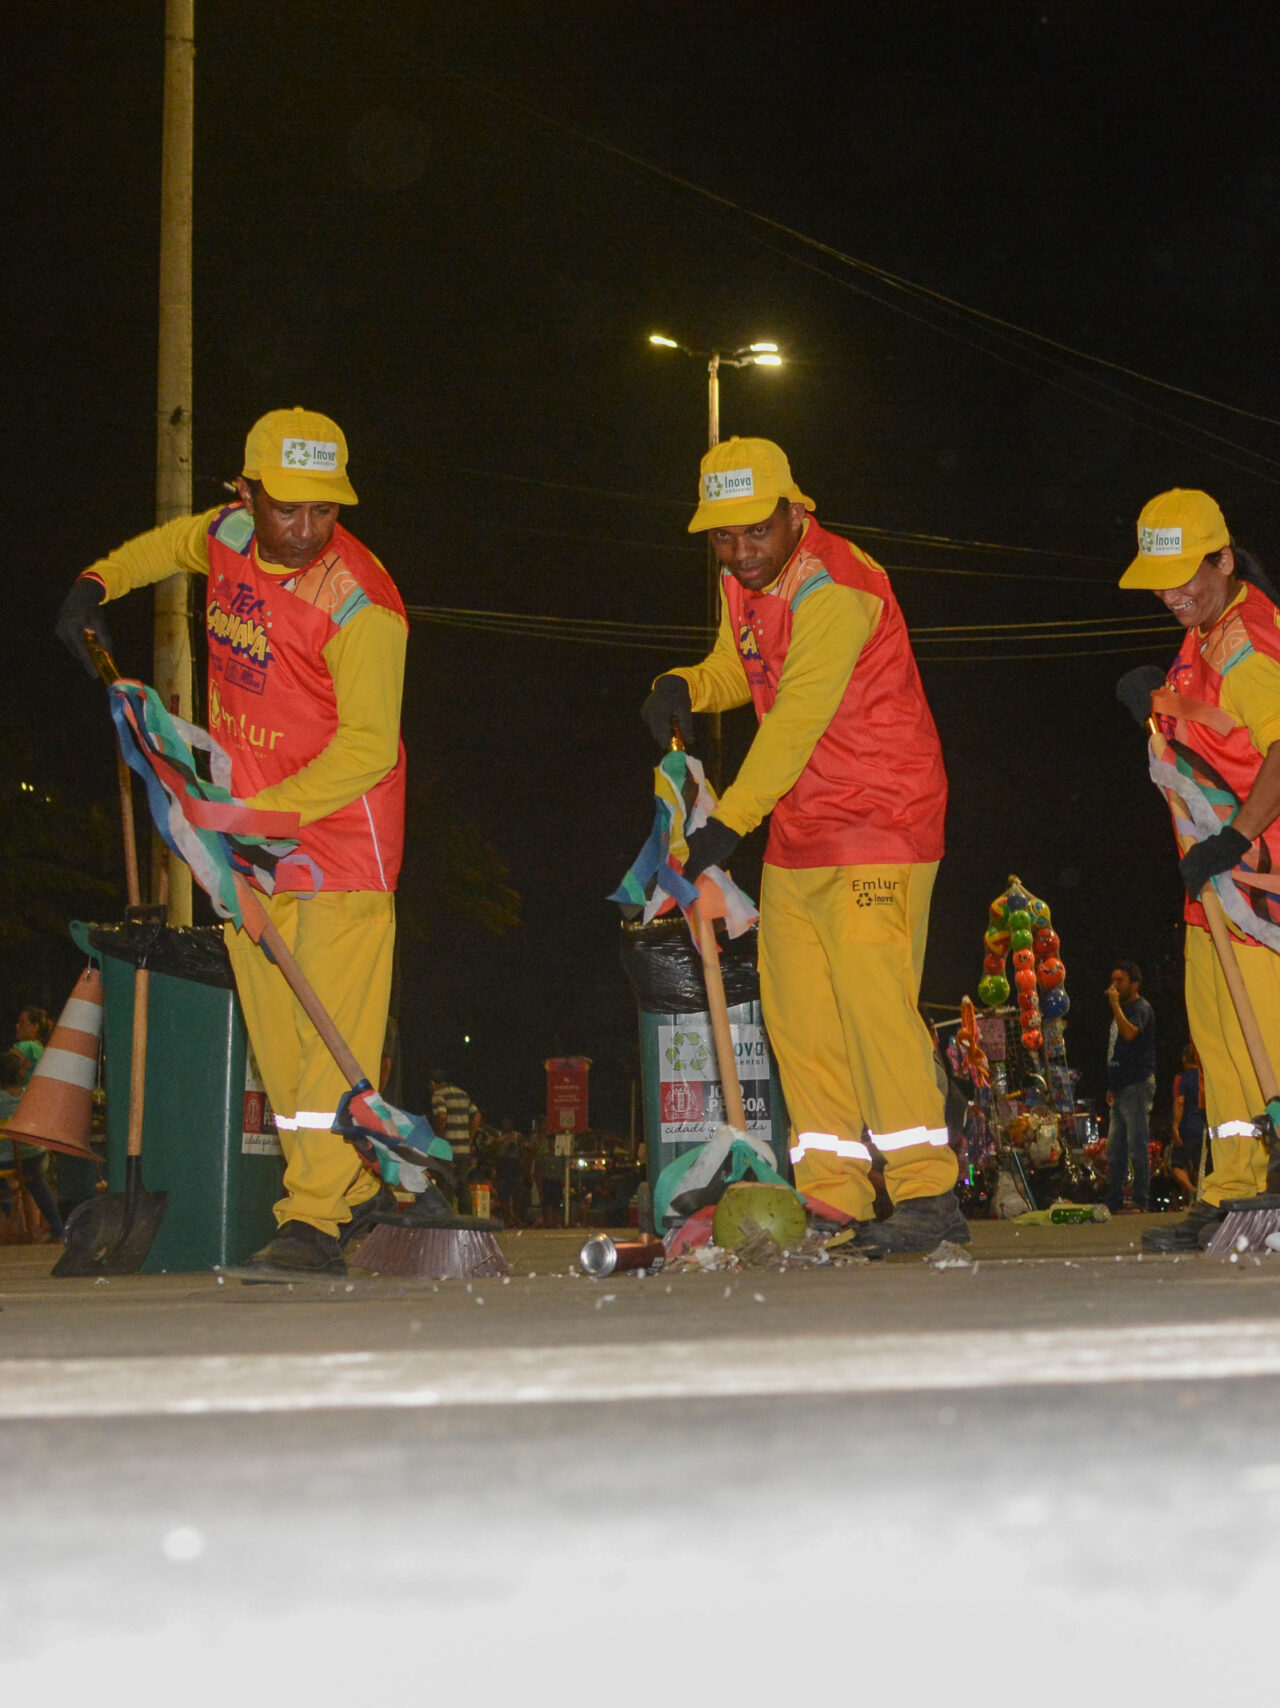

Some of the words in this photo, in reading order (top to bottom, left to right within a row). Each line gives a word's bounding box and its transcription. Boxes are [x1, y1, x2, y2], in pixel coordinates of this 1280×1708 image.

[724, 476, 752, 489] Inova
[1155, 534, 1180, 546] Inova
[206, 600, 273, 662] CARNAVA
[221, 705, 285, 750] mlur
[852, 876, 900, 892] Emlur
[733, 1041, 765, 1057] ova
[708, 1097, 766, 1113] PSOA
[665, 1121, 706, 1134] cidade
